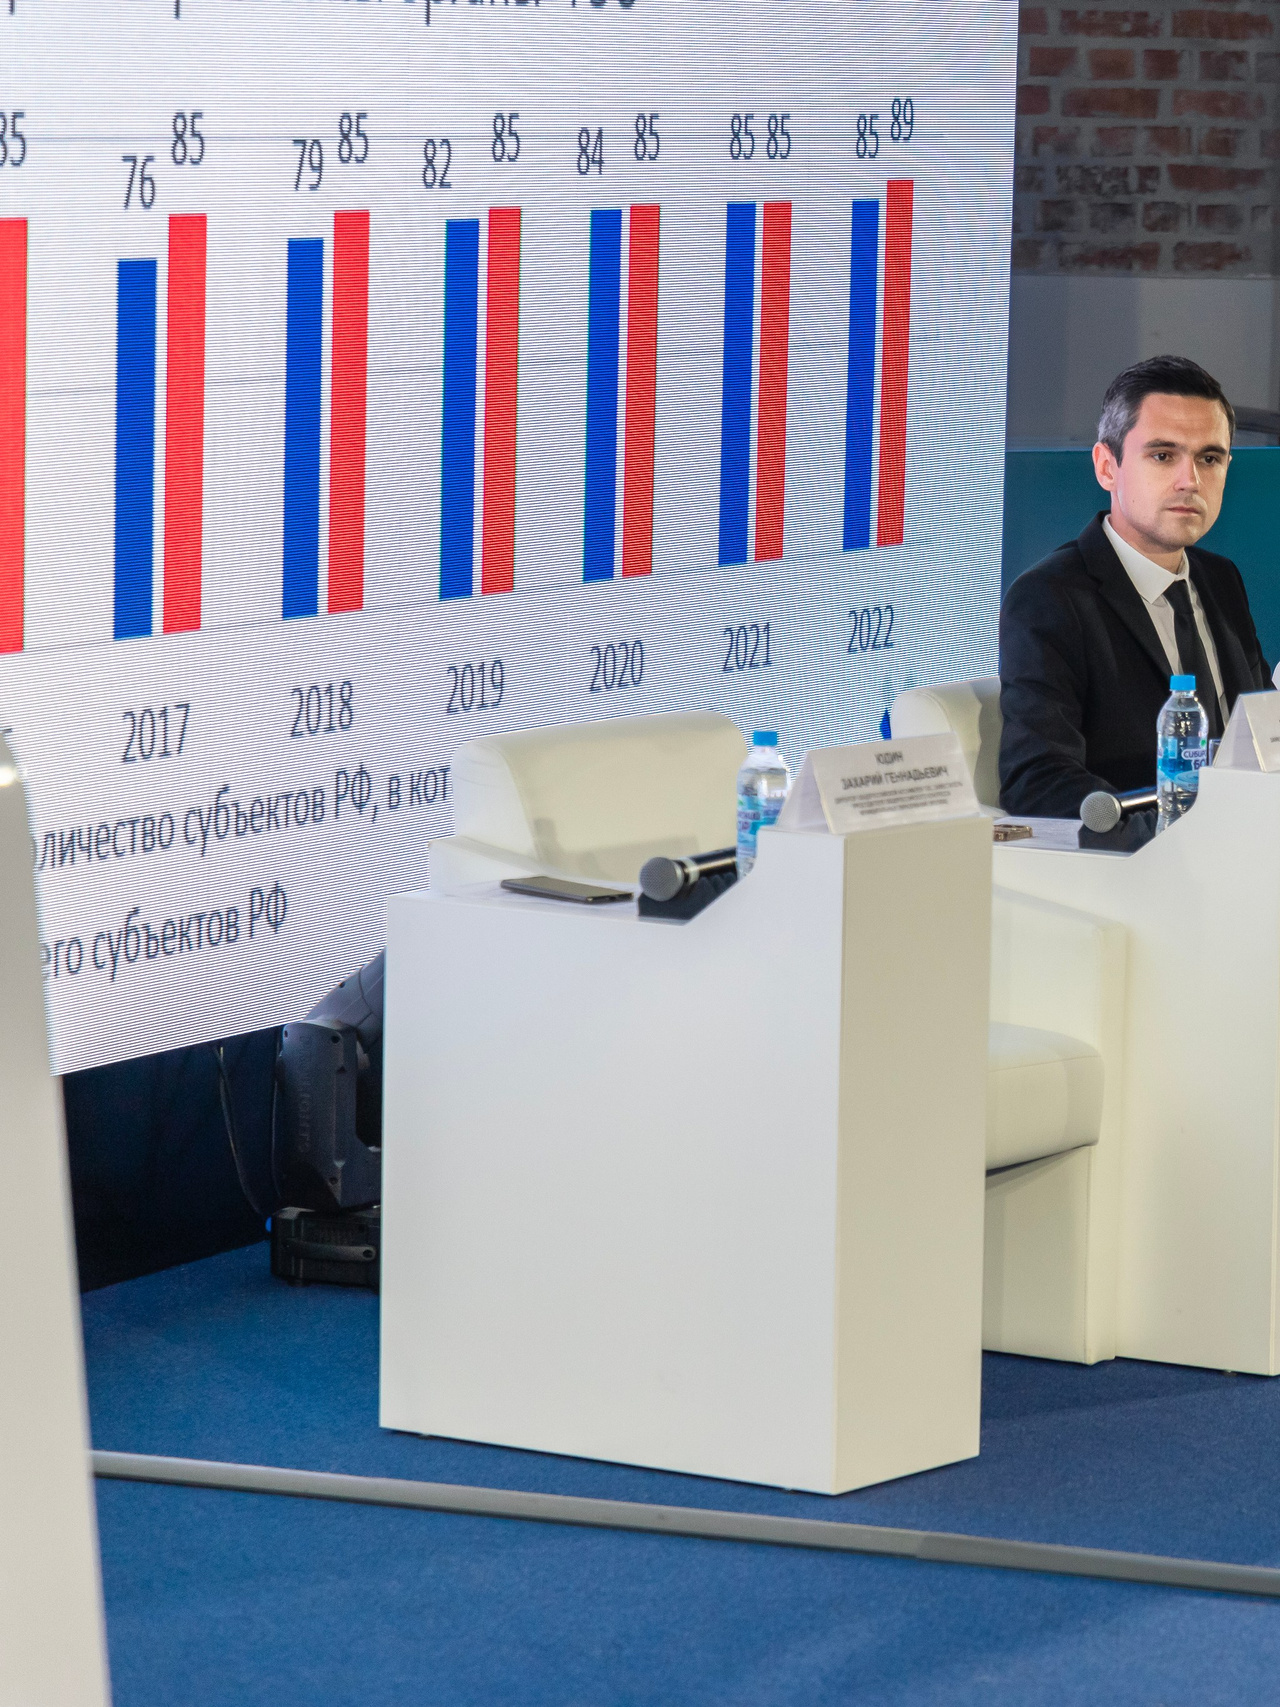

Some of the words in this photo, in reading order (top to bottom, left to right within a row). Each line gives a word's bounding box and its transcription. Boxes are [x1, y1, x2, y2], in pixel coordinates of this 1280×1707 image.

[172, 111, 205, 165] 85
[338, 112, 369, 163] 85
[492, 112, 520, 162] 85
[635, 112, 660, 161] 85
[730, 113, 755, 160] 85
[765, 113, 791, 160] 85
[856, 113, 880, 159] 85
[890, 97, 914, 142] 89
[293, 139, 323, 191] 79
[423, 138, 452, 189] 82
[577, 126, 604, 175] 84
[122, 155, 156, 210] 76
[722, 621, 773, 673] 2021
[847, 604, 895, 654] 2022
[446, 659, 505, 714] 2019
[588, 639, 645, 693] 2020
[121, 702, 191, 764] 2017
[290, 680, 354, 739] 2018
[36, 811, 175, 872] личество
[184, 783, 326, 858] субъектов
[334, 763, 380, 824] РФ,
[387, 774, 401, 811] в
[409, 766, 451, 808] кот
[93, 906, 241, 983] субъектов
[249, 880, 288, 940] РФ
